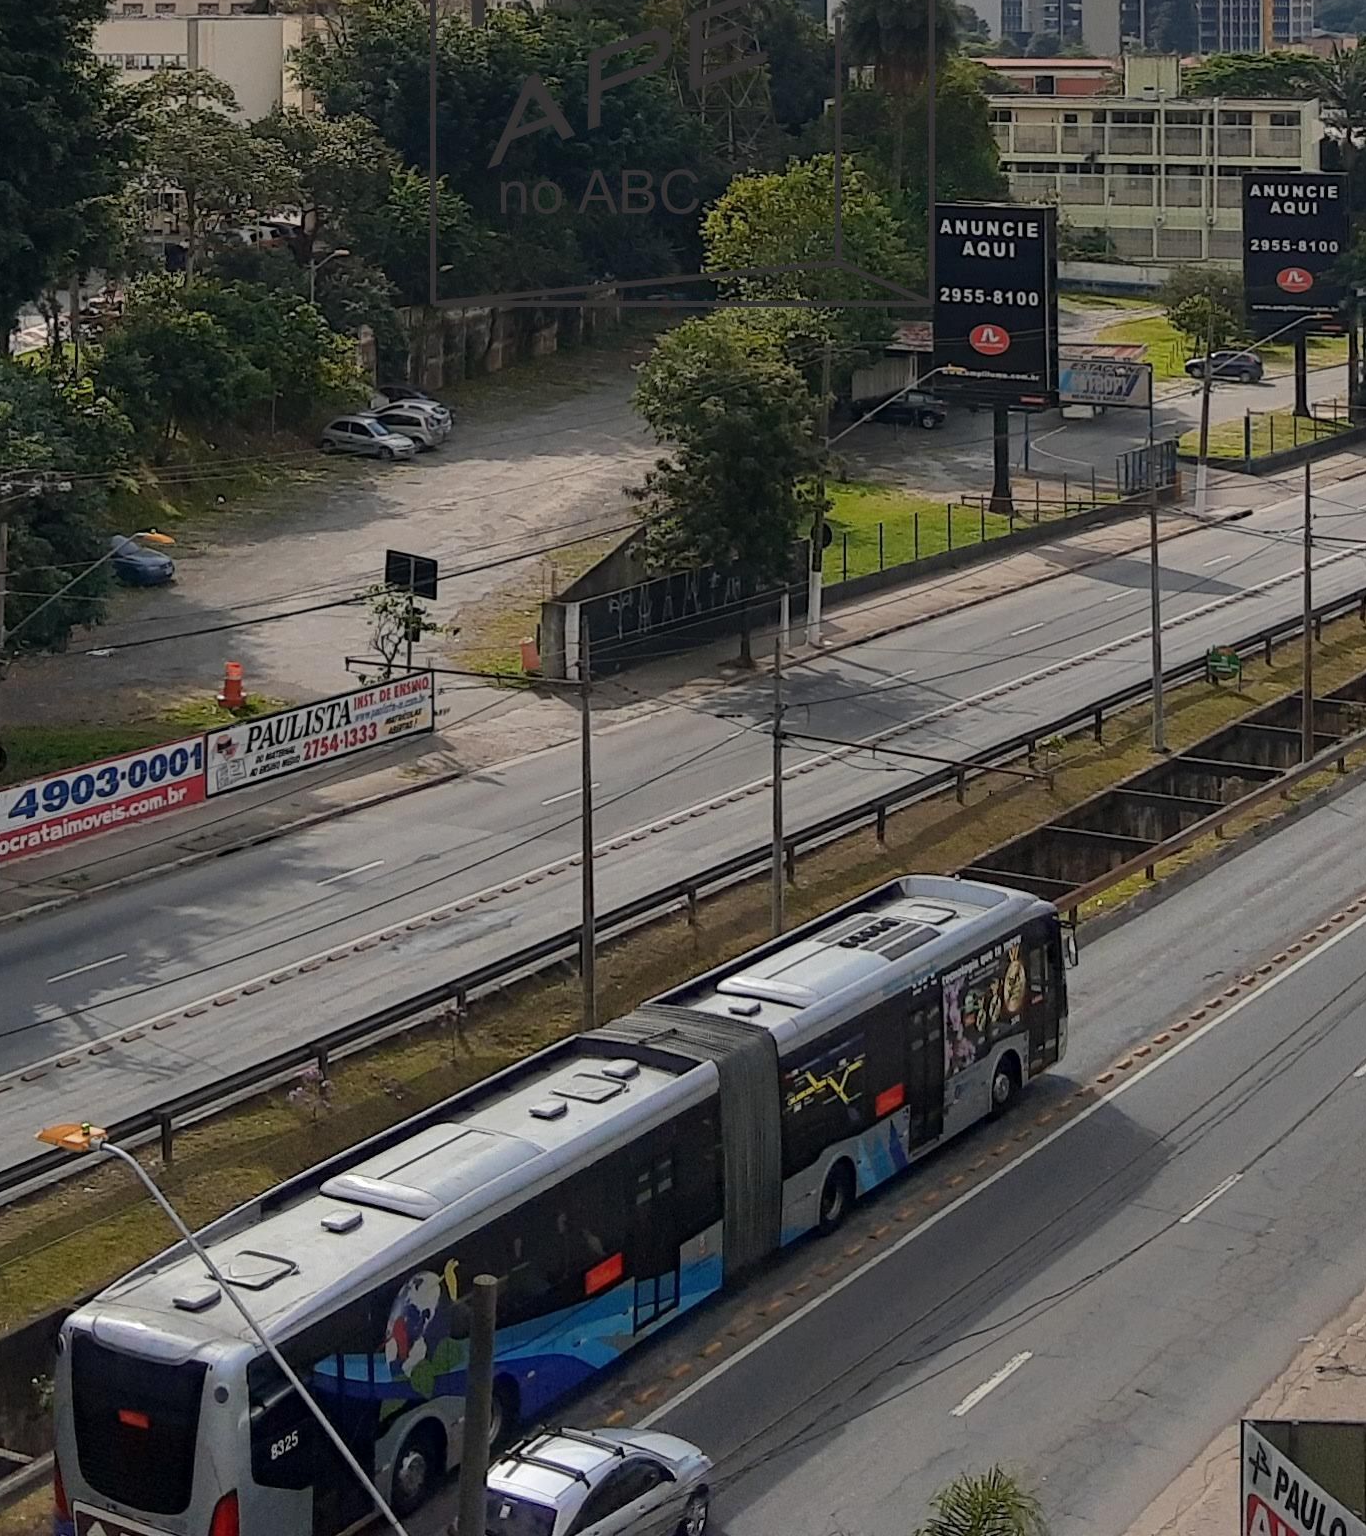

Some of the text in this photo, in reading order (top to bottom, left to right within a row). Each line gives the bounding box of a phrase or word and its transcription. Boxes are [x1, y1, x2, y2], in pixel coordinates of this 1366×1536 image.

[1249, 184, 1339, 199] ANUNCIE
[1269, 201, 1318, 215] AQUI
[939, 219, 1039, 238] ANUNCIE
[961, 241, 1016, 258] AQUI
[1250, 239, 1339, 253] 2955-8100
[939, 287, 1039, 307] 2955-8100
[244, 699, 352, 754] PAULISTA
[270, 1430, 299, 1461] 8325
